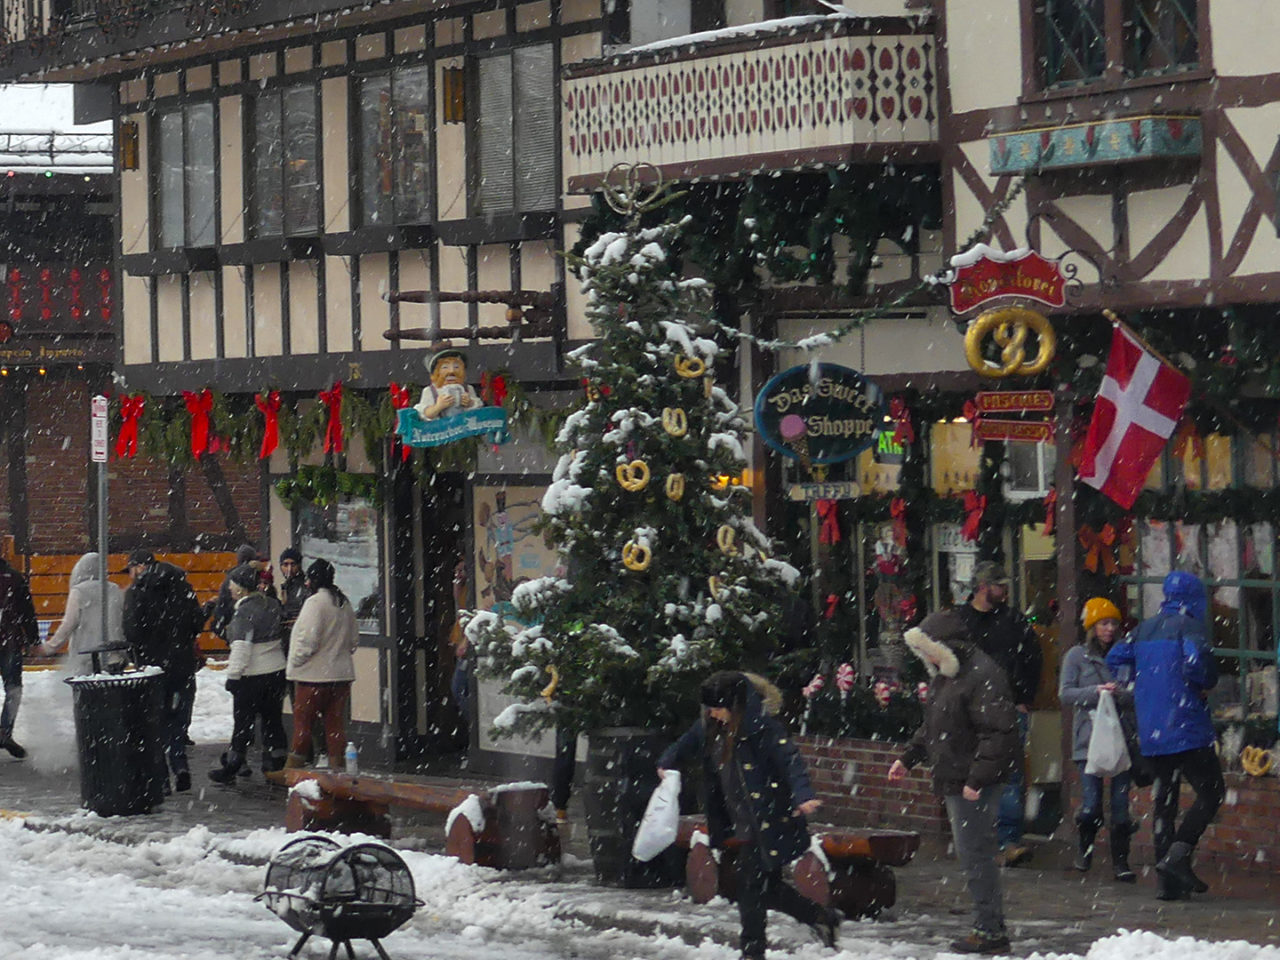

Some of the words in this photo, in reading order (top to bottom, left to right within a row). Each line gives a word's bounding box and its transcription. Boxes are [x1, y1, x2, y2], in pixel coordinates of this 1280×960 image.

[768, 383, 814, 413] Das
[818, 377, 875, 414] Sweet
[807, 413, 873, 438] Shoppe
